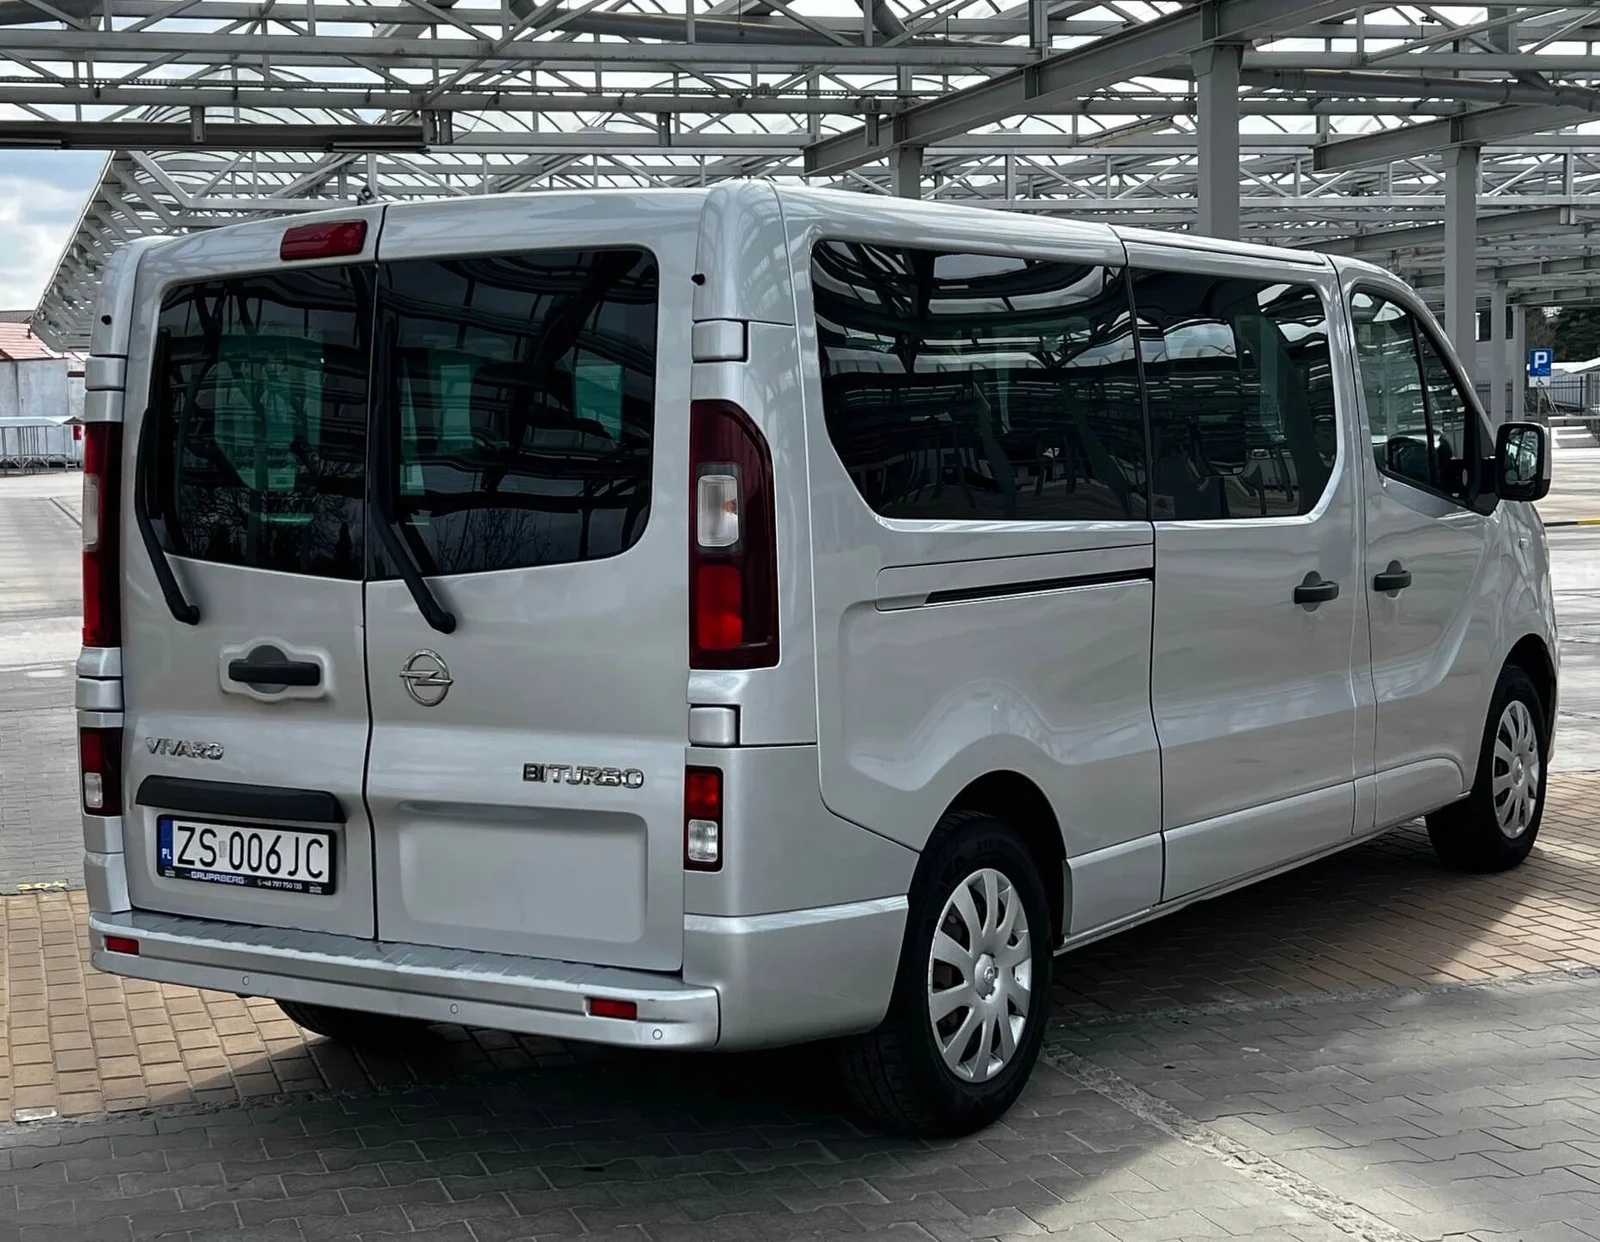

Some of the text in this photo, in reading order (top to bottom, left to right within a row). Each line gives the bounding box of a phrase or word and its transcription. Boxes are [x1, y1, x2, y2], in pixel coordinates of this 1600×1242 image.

[1534, 351, 1548, 369] P
[146, 737, 224, 760] VIVARO
[523, 762, 645, 789] BITURBO
[161, 848, 172, 860] PL
[177, 825, 324, 879] ZS 006JC
[191, 871, 245, 884] GRUPABERG
